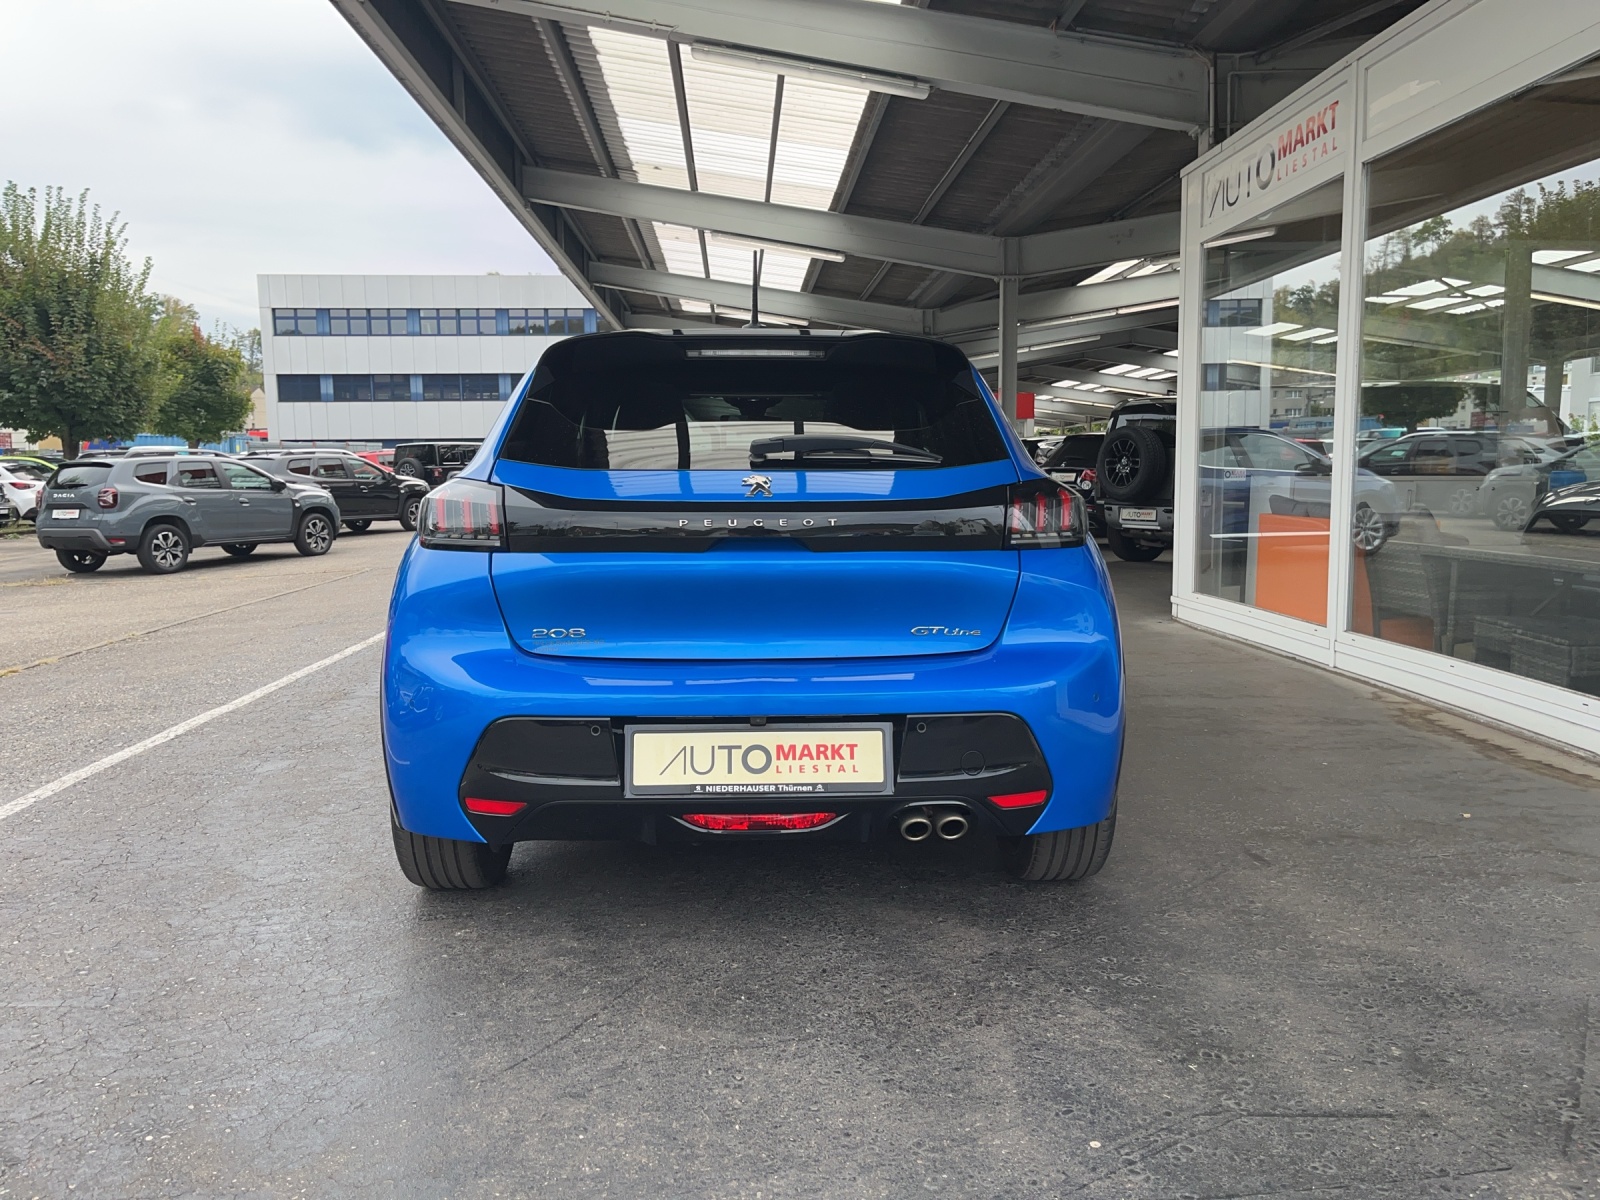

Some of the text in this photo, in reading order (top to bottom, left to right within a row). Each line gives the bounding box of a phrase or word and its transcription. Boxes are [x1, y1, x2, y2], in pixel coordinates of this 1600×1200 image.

[1207, 100, 1340, 219] AUTO MARKT
[1276, 136, 1338, 182] LIESTAL
[678, 518, 838, 527] PEUGEOT
[531, 628, 586, 638] 208
[659, 743, 859, 776] AUTO MARKT
[775, 763, 859, 774] LIESTAL
[705, 783, 813, 793] NIEDERHAUSER Thürnen
